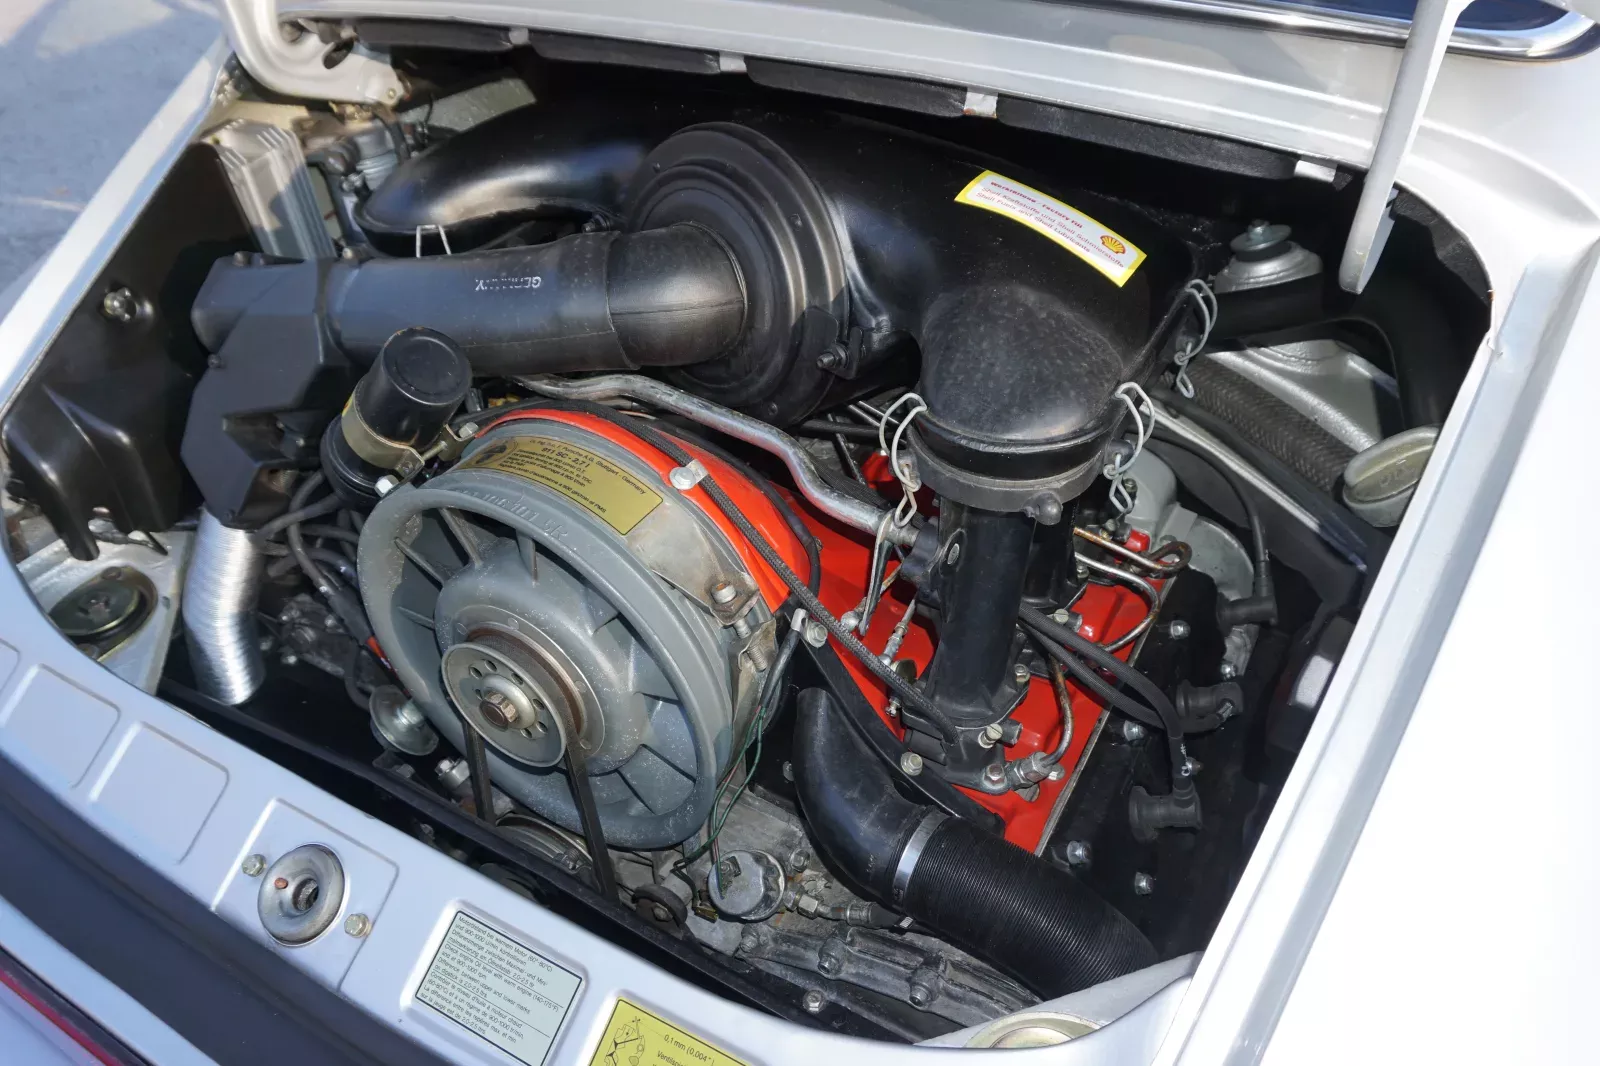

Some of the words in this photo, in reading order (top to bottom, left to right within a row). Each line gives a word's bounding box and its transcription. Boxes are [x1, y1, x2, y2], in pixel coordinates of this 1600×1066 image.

[1042, 213, 1056, 223] und
[1056, 220, 1076, 236] Shell
[1054, 226, 1090, 253] Lubricants
[596, 460, 619, 475] Stuttgart
[621, 475, 646, 495] Germany
[594, 502, 606, 513] PMS
[464, 928, 485, 942] 900-1000
[441, 950, 450, 958] and
[513, 947, 527, 957] Motor
[444, 943, 458, 954] Check
[459, 952, 474, 963] engine
[481, 965, 493, 974] level
[493, 971, 503, 980] with
[503, 977, 516, 988] warm
[516, 985, 532, 997] engine
[485, 948, 505, 963] zwischen
[526, 971, 535, 980] und
[441, 967, 458, 980] dipstick
[479, 981, 492, 992] upper
[492, 989, 502, 998] and
[502, 995, 515, 1005] lower
[433, 999, 446, 1011] jauge
[446, 1007, 454, 1015] est
[452, 1001, 464, 1012] entre
[464, 1009, 472, 1017] les
[456, 986, 471, 998] niveau
[490, 1007, 507, 1020] moteur
[507, 1017, 522, 1029] chaud
[488, 1014, 509, 1030] 900-1000
[664, 1034, 674, 1044] 0,1
[674, 1040, 686, 1051] mm
